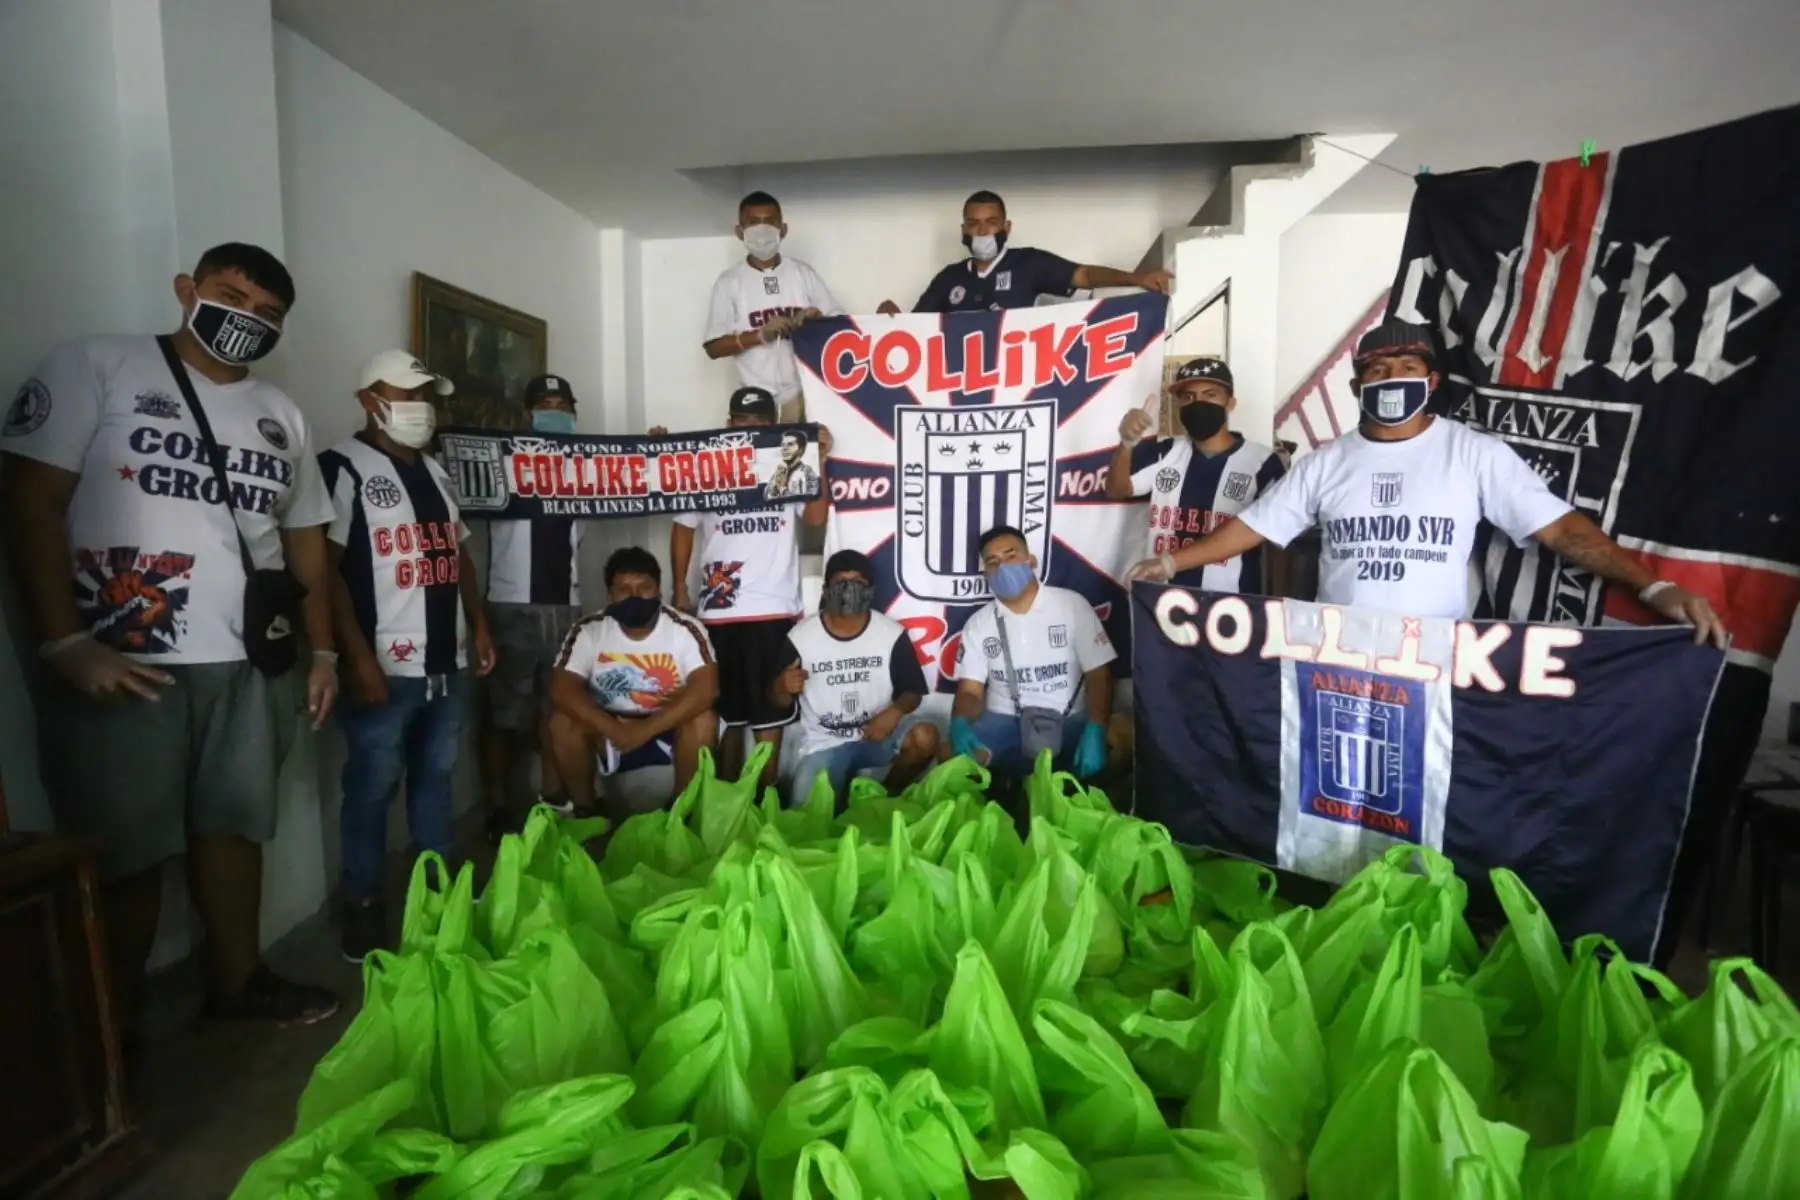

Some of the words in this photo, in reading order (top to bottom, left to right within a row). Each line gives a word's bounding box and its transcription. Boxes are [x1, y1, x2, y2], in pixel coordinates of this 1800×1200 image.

[916, 410, 1036, 433] ALIANZA
[1455, 391, 1600, 449] AIANZA
[129, 427, 293, 488] COLLIKE
[573, 443, 622, 453] CONO
[636, 441, 697, 454] NORTE
[513, 453, 648, 498] COLLIKE
[657, 445, 758, 495] GRONE
[829, 477, 891, 501] ONO
[904, 462, 924, 538] CLUB
[1025, 460, 1046, 534] LIMA
[543, 500, 591, 515] BLACK
[596, 499, 644, 514] LINXES
[648, 497, 666, 511] LA
[722, 517, 780, 535] GRONE
[1418, 516, 1455, 545] SVR
[395, 556, 459, 589] GRON
[1357, 560, 1405, 582] 2019
[952, 579, 992, 597] 1901
[811, 661, 833, 673] LOS
[826, 671, 871, 686] COLLIKE
[1312, 671, 1409, 704] ALIANZA
[1329, 697, 1391, 719] ALIANZA
